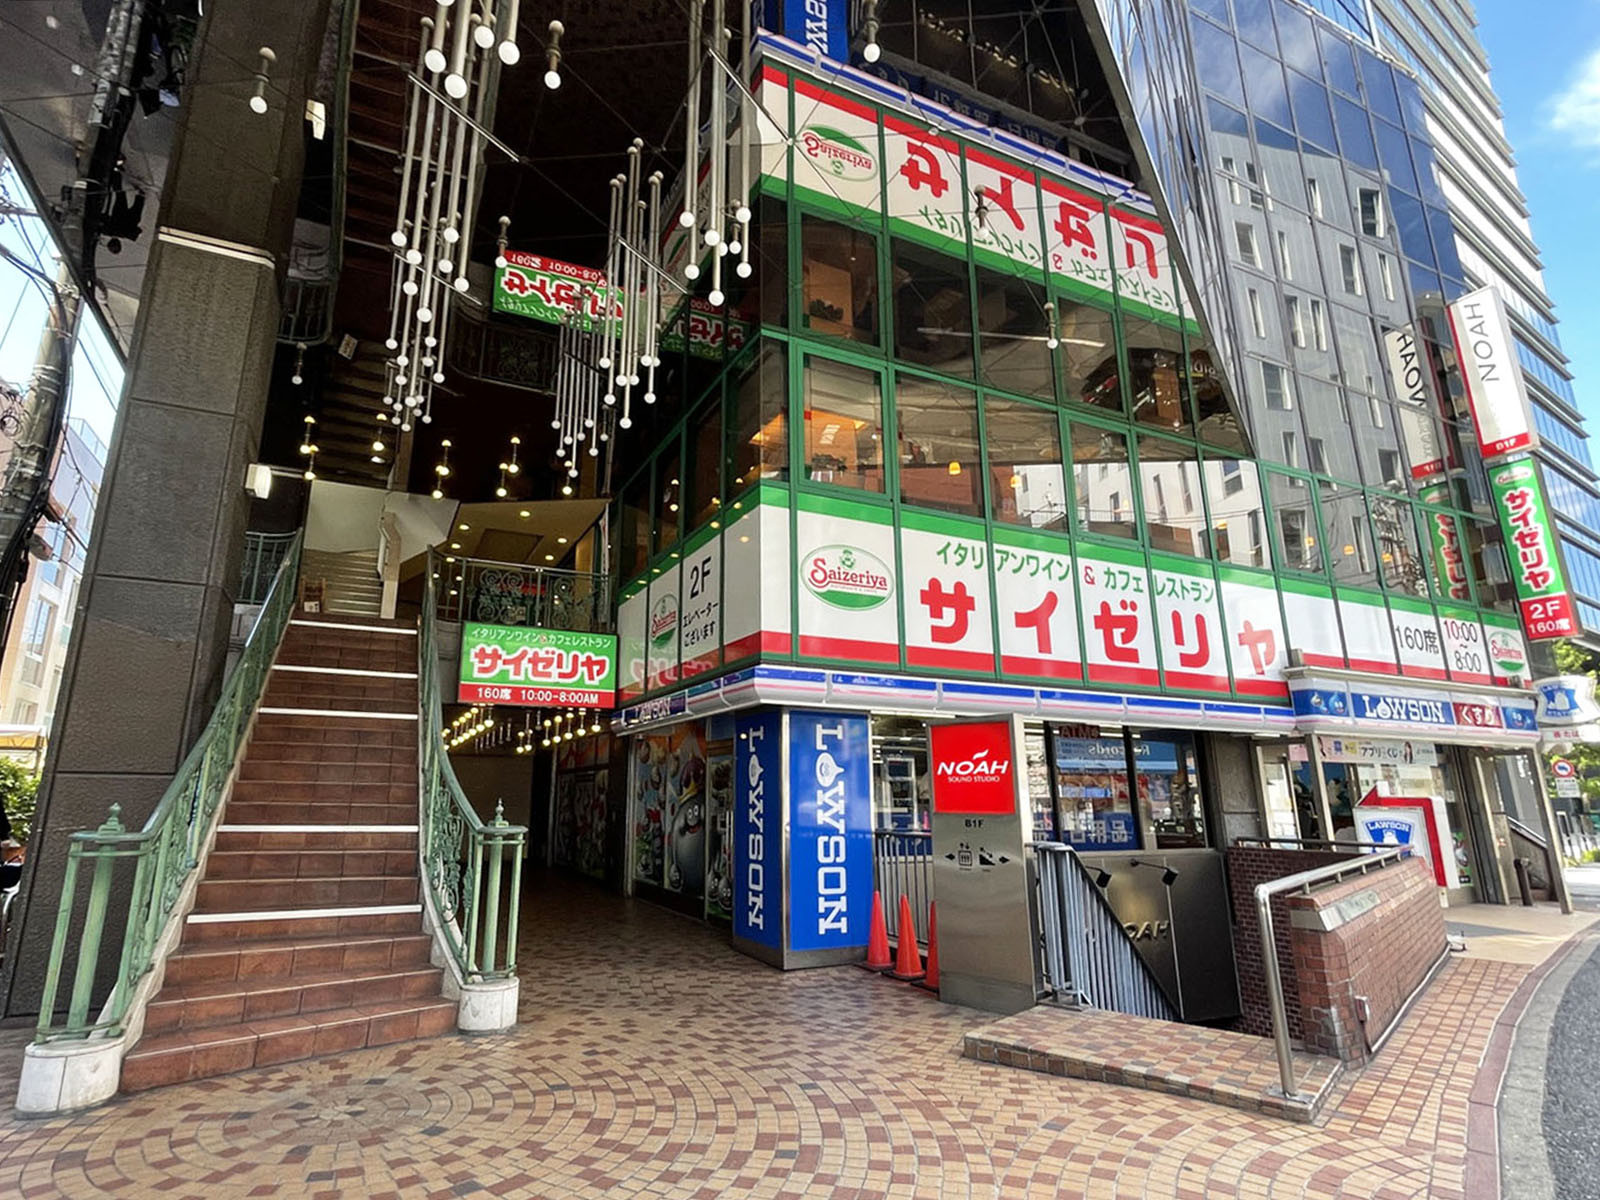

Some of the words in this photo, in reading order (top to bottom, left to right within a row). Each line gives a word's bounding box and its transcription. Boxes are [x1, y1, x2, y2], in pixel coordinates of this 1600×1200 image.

[1463, 302, 1501, 382] NOAH
[1504, 489, 1552, 591] サイゼリヤ
[690, 556, 711, 599] 2F
[809, 558, 888, 589] Saizeriya
[1530, 600, 1561, 619] 2F
[920, 577, 1275, 675] サイゼリヤ
[1443, 620, 1478, 643] 10:00
[1396, 625, 1440, 655] 160席
[472, 645, 608, 683] サイゼリヤ
[1455, 651, 1481, 673] 8:00
[521, 690, 599, 704] 10:00-8:00AM
[937, 760, 1009, 775] NOAH
[947, 775, 972, 783] SOUND
[974, 775, 1000, 783] STUDIO
[1122, 920, 1170, 939] OAH
